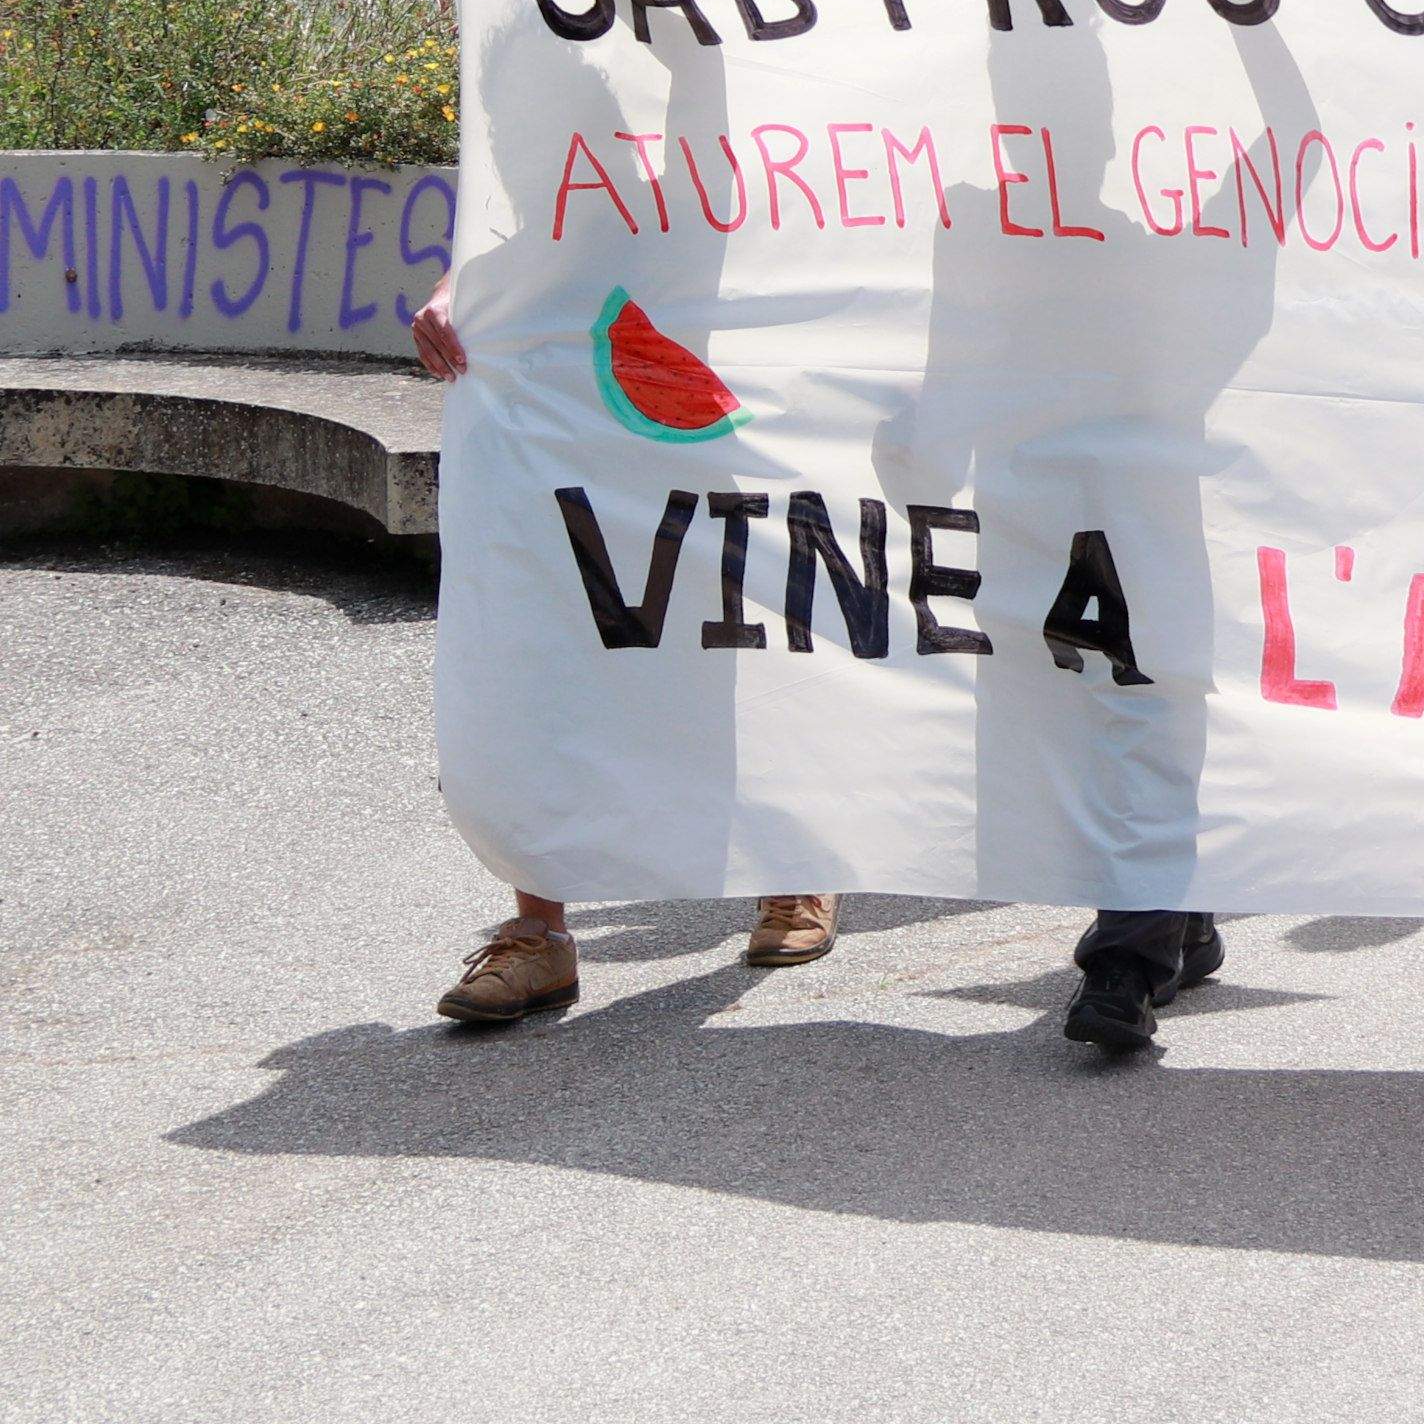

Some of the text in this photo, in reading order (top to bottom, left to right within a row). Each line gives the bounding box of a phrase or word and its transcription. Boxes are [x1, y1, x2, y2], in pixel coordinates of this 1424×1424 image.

[550, 122, 952, 242] ATUREM
[997, 124, 1106, 242] EL
[554, 486, 994, 659] VINE
[1042, 530, 1154, 686] A
